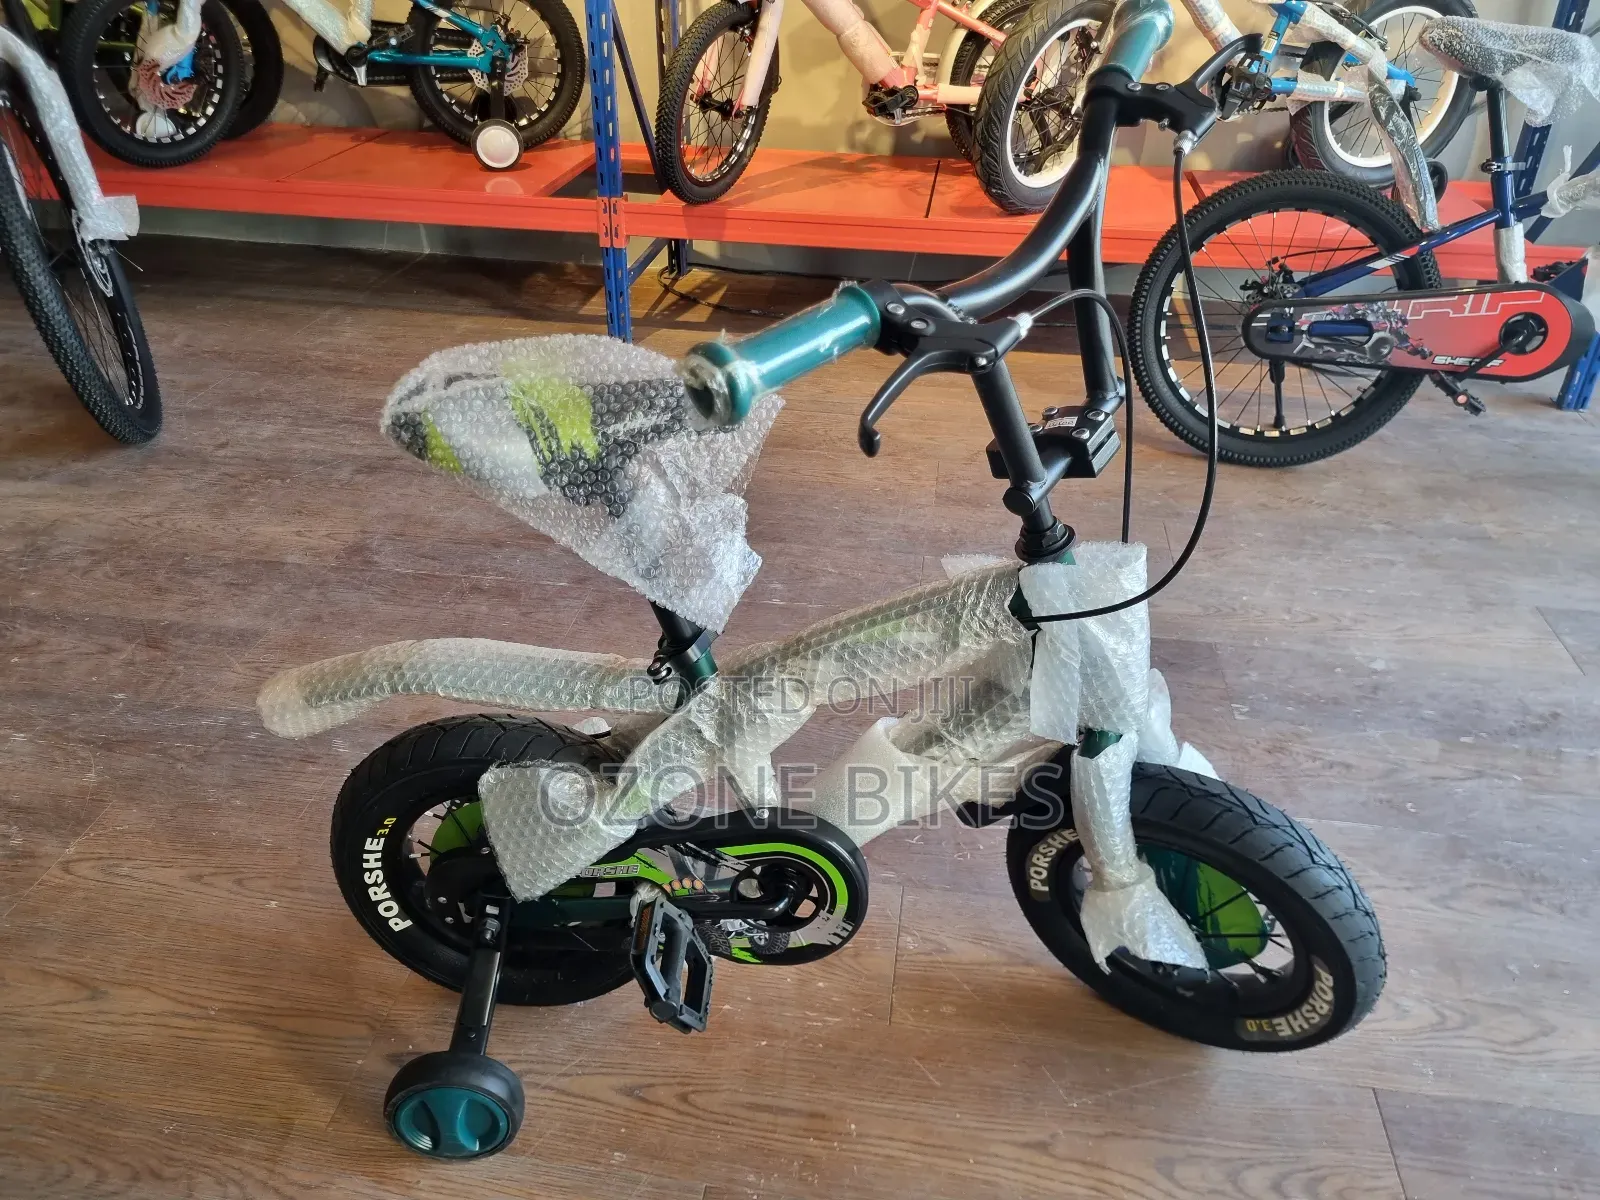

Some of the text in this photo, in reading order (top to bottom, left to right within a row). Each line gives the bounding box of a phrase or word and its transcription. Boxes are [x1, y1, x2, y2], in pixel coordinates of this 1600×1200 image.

[362, 817, 414, 932] PORSHE 3.0
[578, 864, 640, 878] ORSHE
[1029, 828, 1080, 892] PORSHE
[1271, 964, 1335, 1037] PORSHE
